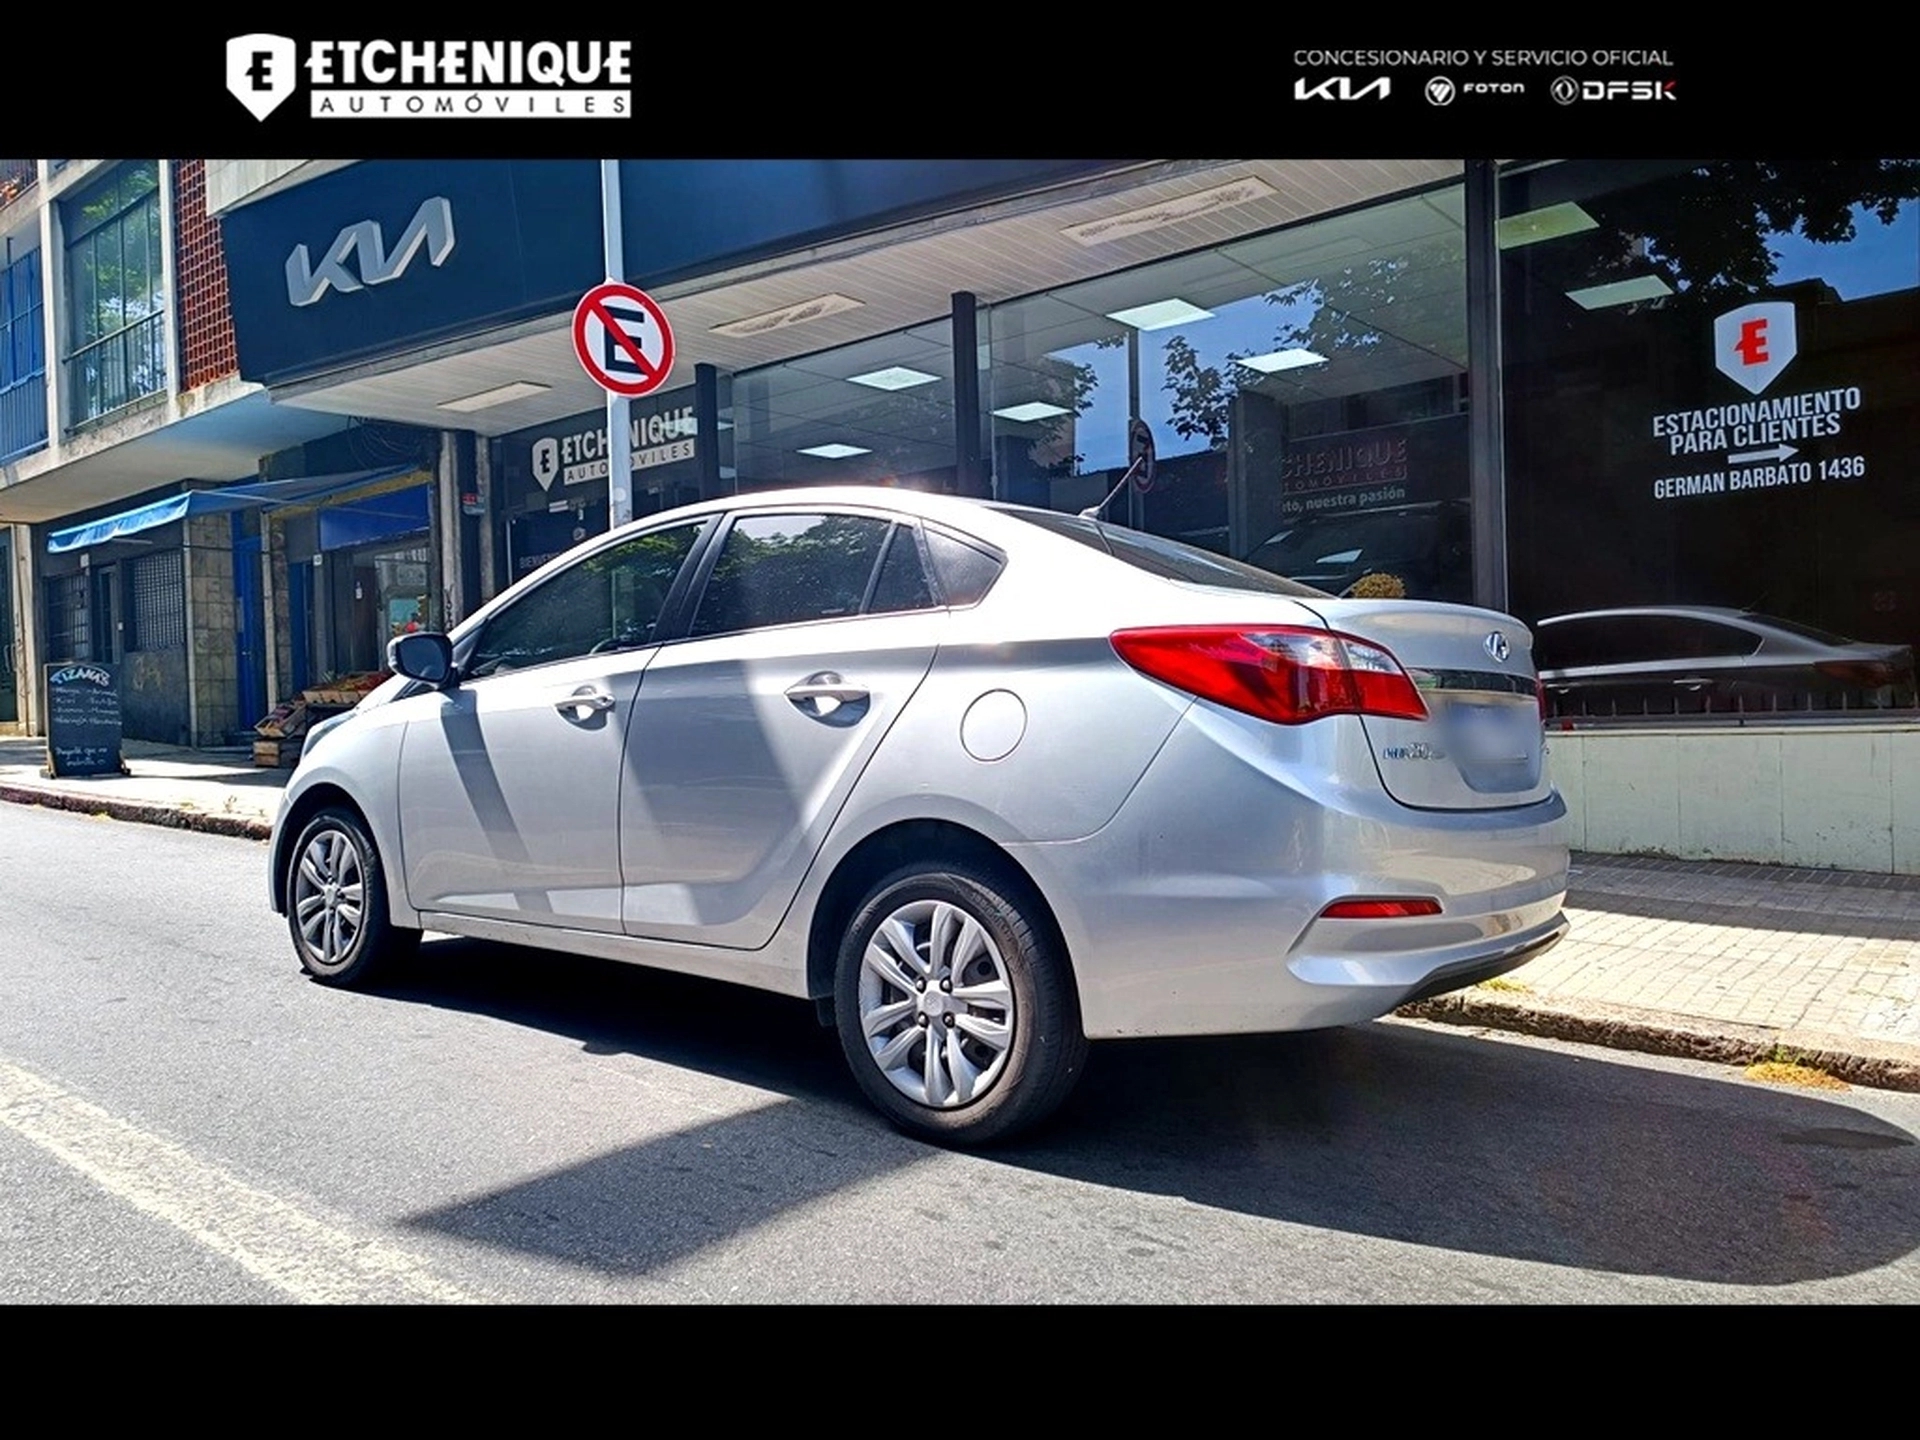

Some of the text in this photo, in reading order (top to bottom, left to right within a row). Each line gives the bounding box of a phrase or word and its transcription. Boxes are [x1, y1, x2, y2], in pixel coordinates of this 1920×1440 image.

[603, 305, 644, 375] E
[561, 406, 696, 464] ETCHNIQUE
[1653, 387, 1861, 437] ESTACIONAMIENTO
[1670, 412, 1841, 455] PARA CLIENTES
[1306, 493, 1356, 510] nuestra
[1359, 486, 1406, 507] pasión
[1654, 456, 1865, 499] GERMAN BARBATO 1436
